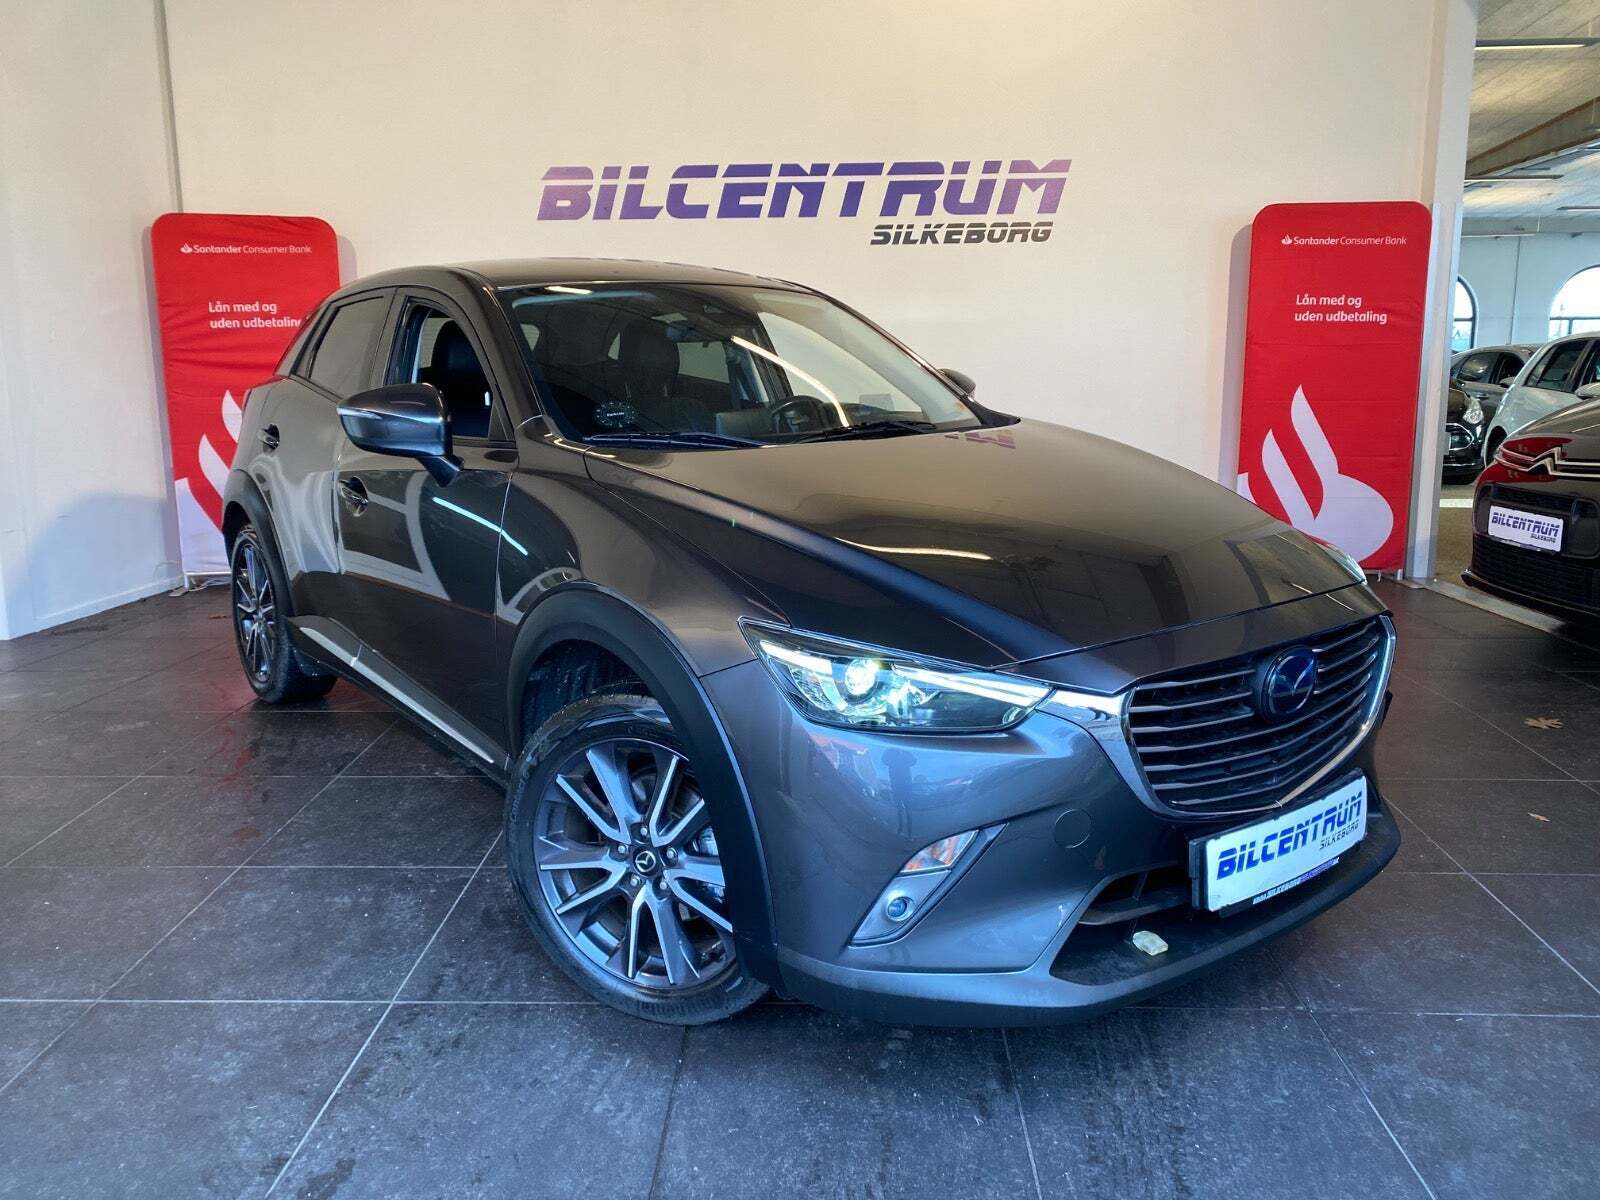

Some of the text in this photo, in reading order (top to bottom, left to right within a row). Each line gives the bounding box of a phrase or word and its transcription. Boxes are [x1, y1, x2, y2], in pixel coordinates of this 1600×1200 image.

[537, 159, 1072, 221] BILCENTRUM
[870, 221, 1054, 245] SILKEBORG
[1293, 236, 1407, 245] Santander Consumer Bank
[193, 244, 312, 254] Santander Consumer Bank
[208, 301, 277, 315] Lån med og
[1296, 294, 1362, 309] Lån med og
[210, 317, 240, 329] uden
[1294, 310, 1387, 324] uden udbetaling
[1492, 512, 1559, 537] BILCENTRUM
[1216, 791, 1362, 881] BILCENTRUM
[1319, 819, 1359, 850] SILKEBORG
